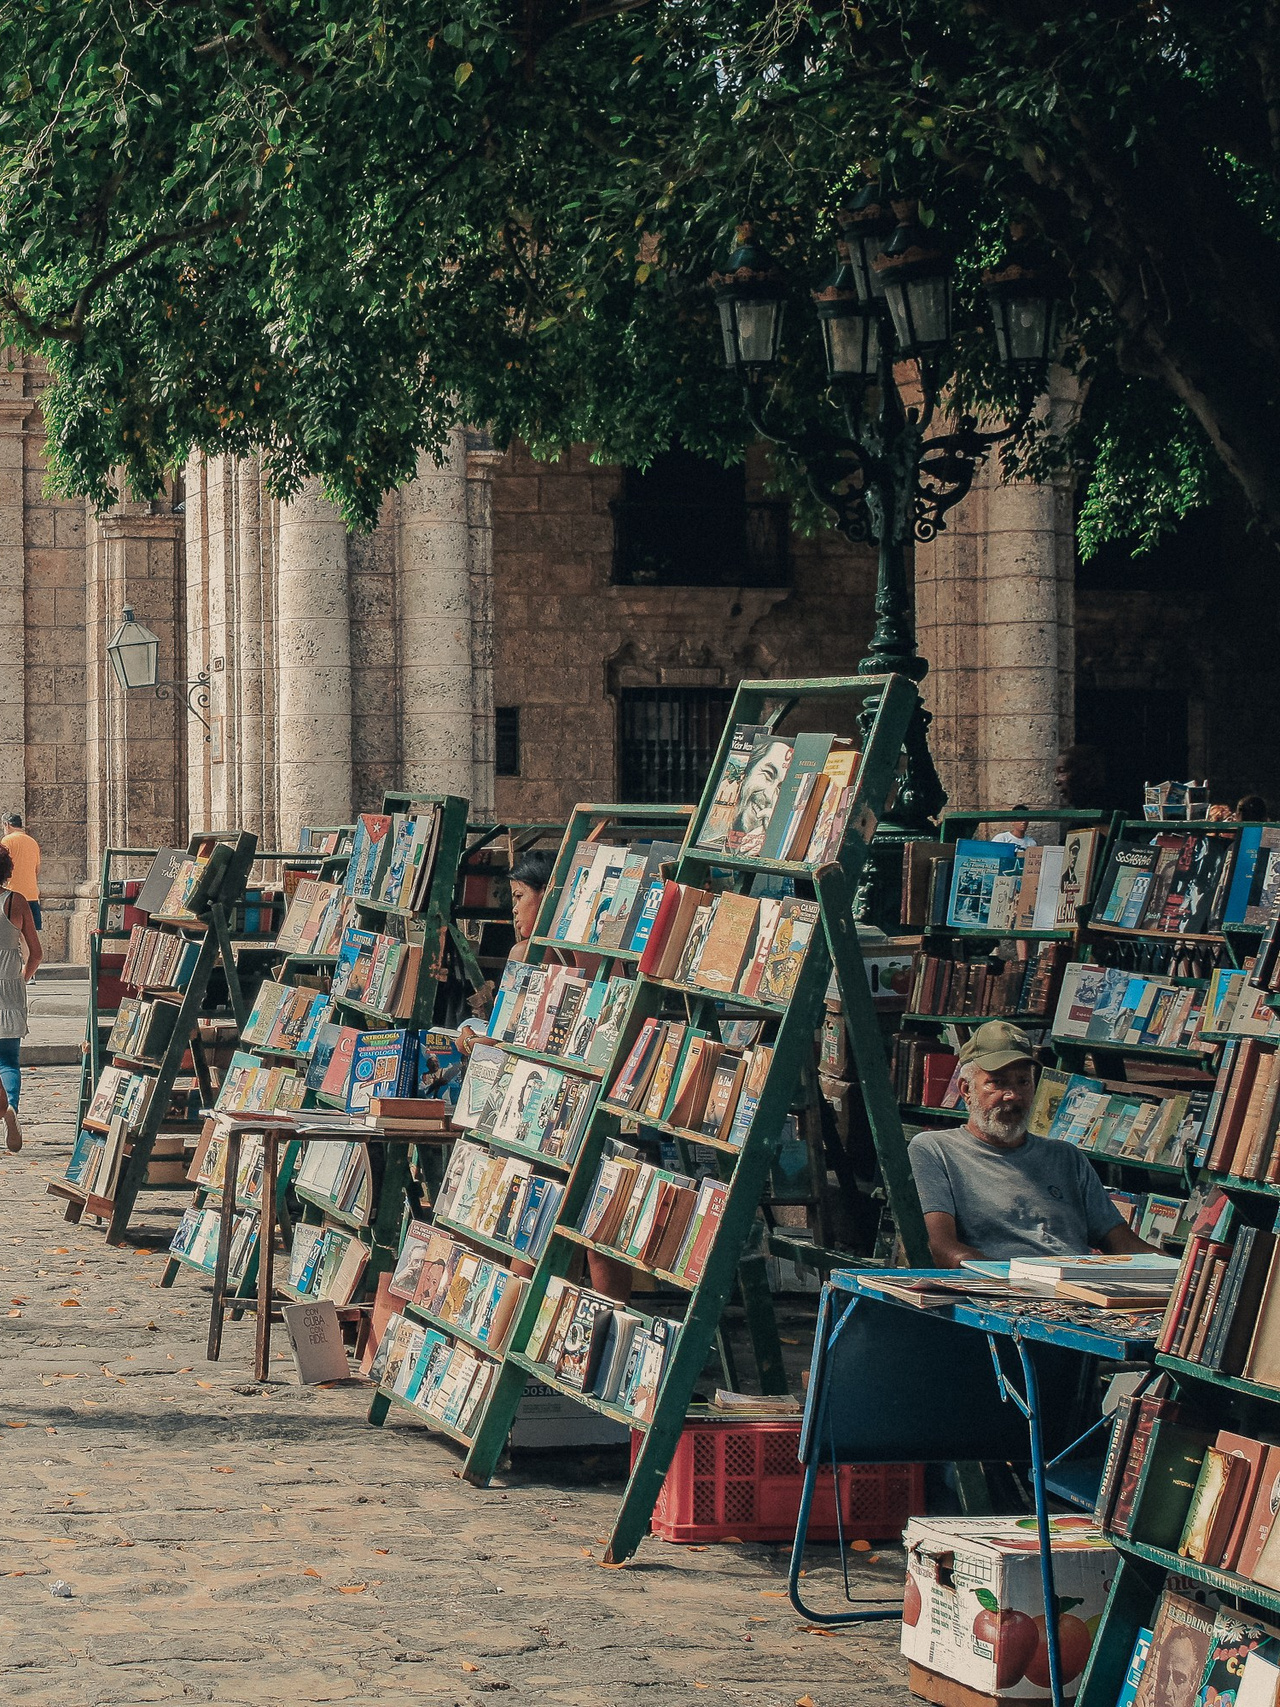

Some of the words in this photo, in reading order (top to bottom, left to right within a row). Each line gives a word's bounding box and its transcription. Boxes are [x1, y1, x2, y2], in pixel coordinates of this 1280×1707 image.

[303, 1315, 326, 1328] CUBA
[305, 1308, 319, 1316] CON
[309, 1333, 329, 1345] FIDEL
[1110, 1418, 1123, 1453] FIDEL
[1100, 1451, 1115, 1496] CASTRO
[1176, 1608, 1214, 1637] PADRINO
